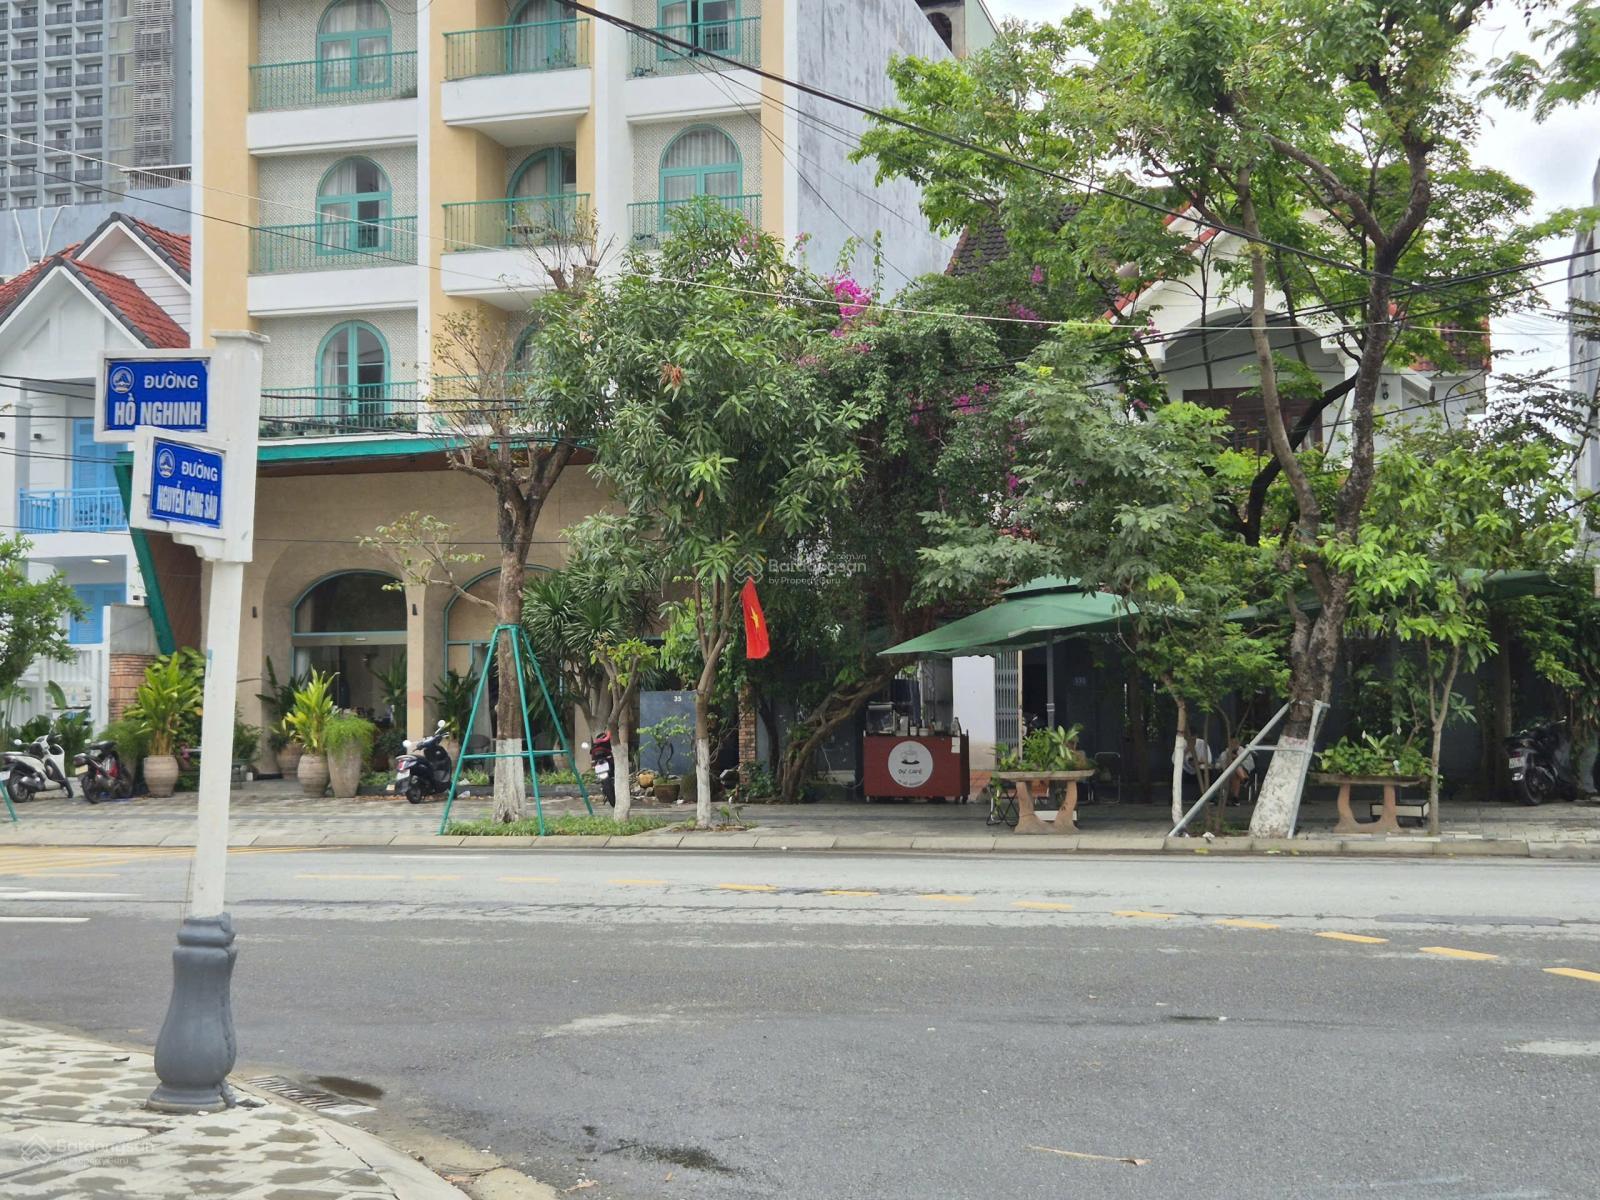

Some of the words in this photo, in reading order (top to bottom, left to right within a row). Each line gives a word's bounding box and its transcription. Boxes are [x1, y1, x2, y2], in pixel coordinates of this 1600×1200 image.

[144, 370, 199, 389] ĐƯỜNG
[114, 392, 136, 426] HỒ
[140, 401, 201, 426] NGHINH
[181, 459, 218, 482] ĐƯỜNG
[156, 480, 185, 514] NGUYỄN
[186, 486, 204, 518] CÔNG
